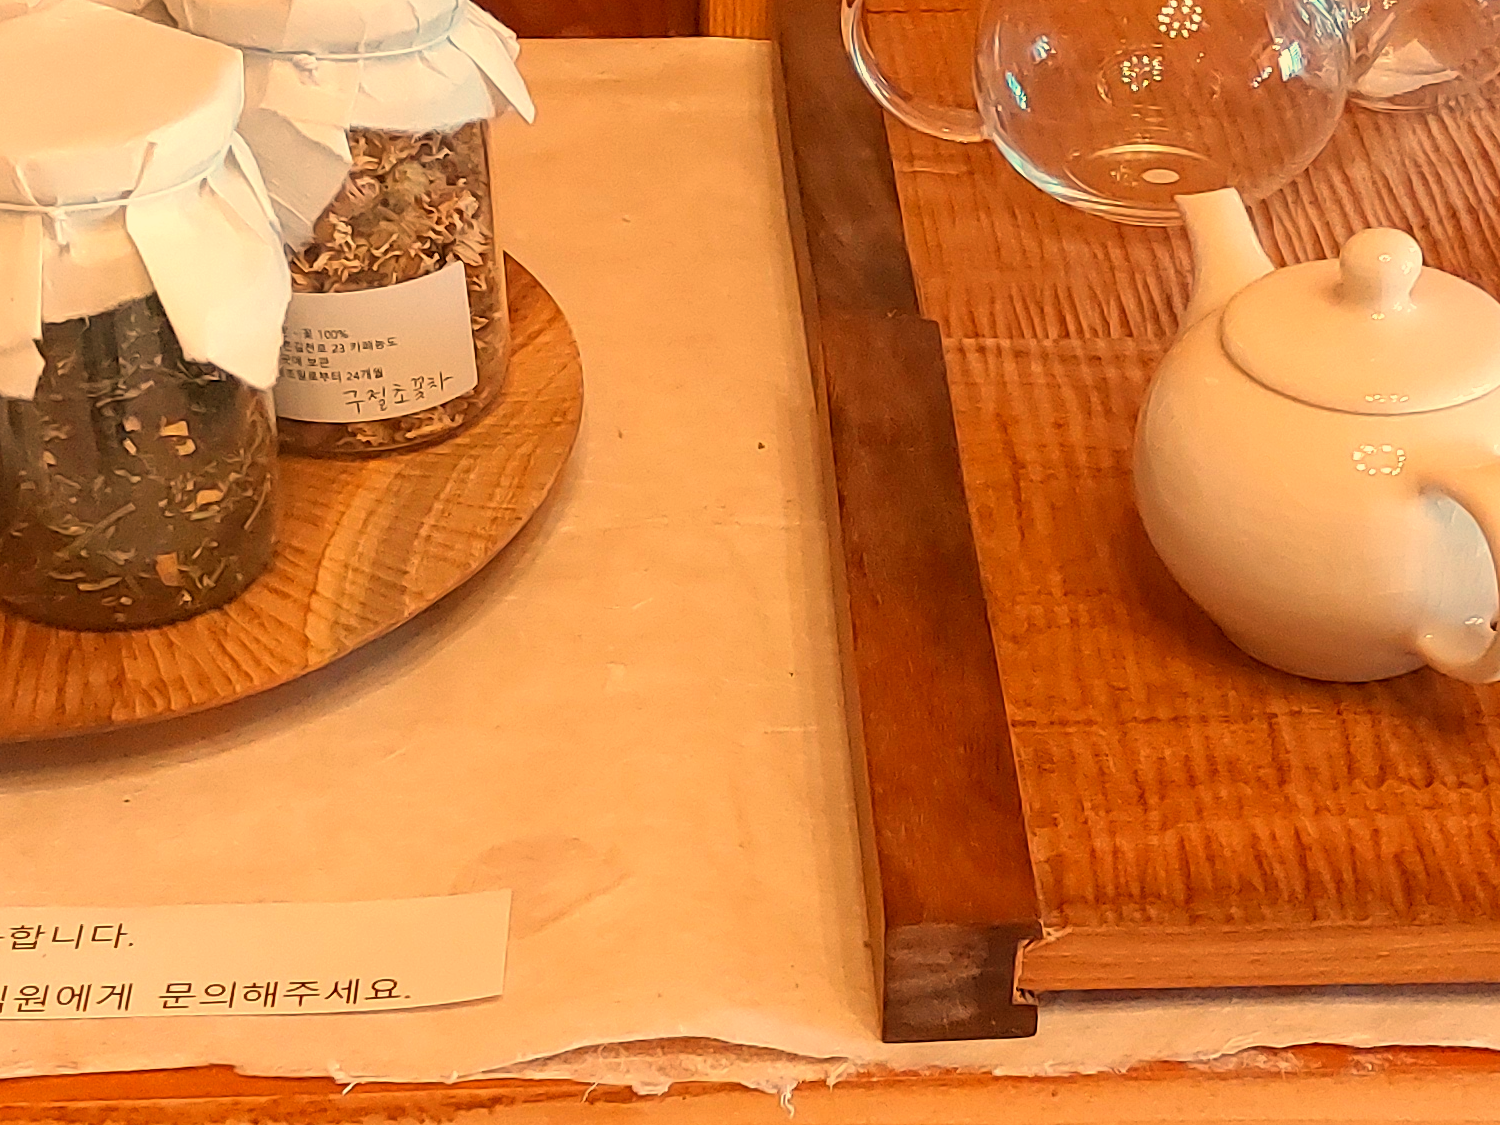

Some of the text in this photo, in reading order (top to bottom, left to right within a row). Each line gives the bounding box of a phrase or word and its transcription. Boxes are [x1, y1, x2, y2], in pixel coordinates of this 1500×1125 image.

[317, 329, 349, 340] 100%
[331, 343, 345, 353] 23
[346, 367, 384, 382] 24개월
[158, 977, 412, 1010] 문의해주세요.
